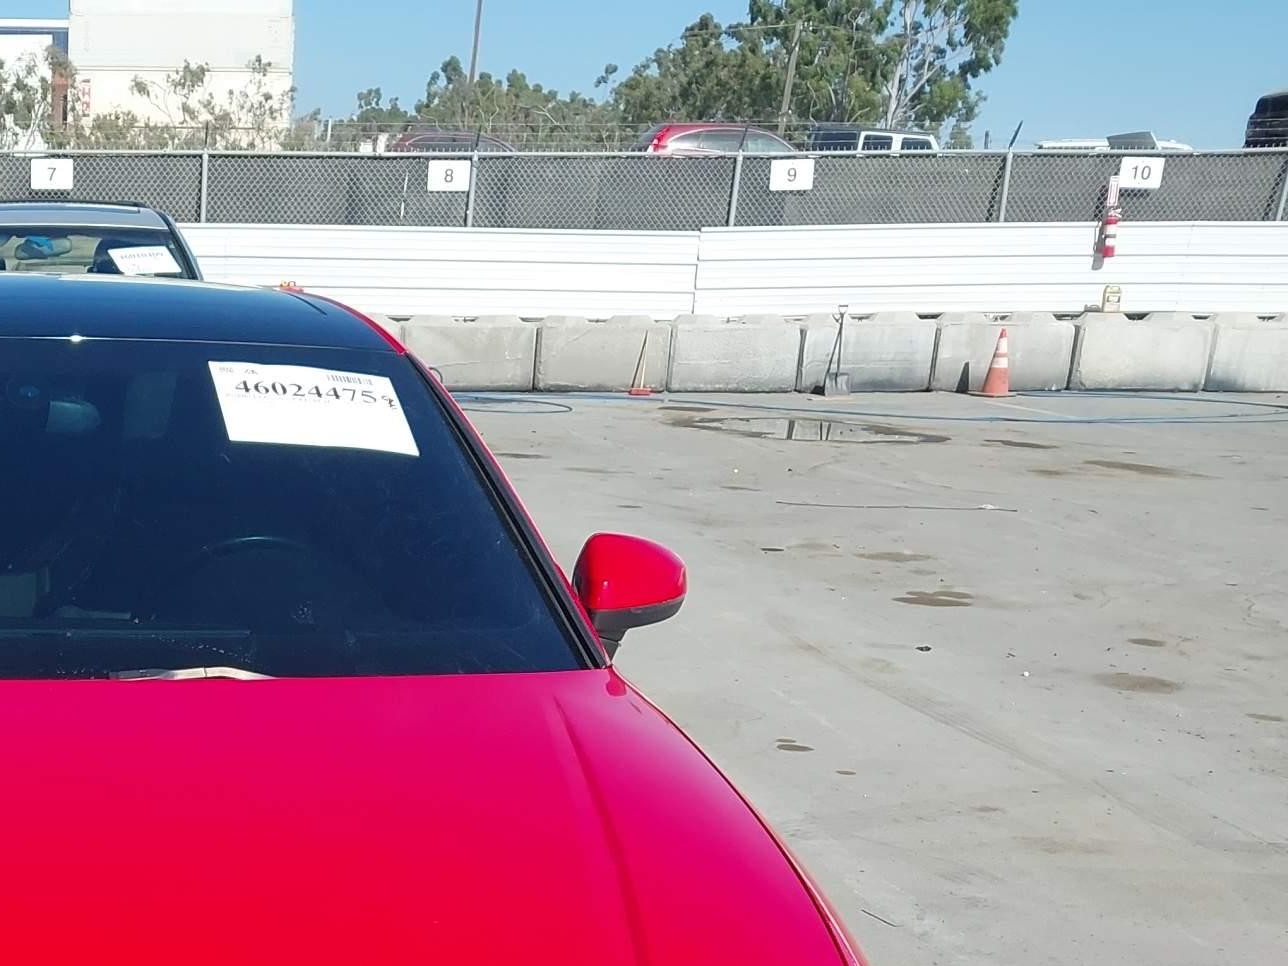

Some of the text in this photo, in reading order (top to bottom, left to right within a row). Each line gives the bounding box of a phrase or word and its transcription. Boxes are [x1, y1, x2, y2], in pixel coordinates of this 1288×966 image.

[47, 167, 57, 181] 7
[444, 168, 454, 183] 8
[787, 167, 797, 182] 9
[1131, 165, 1152, 180] 10
[235, 379, 377, 404] 46024475
